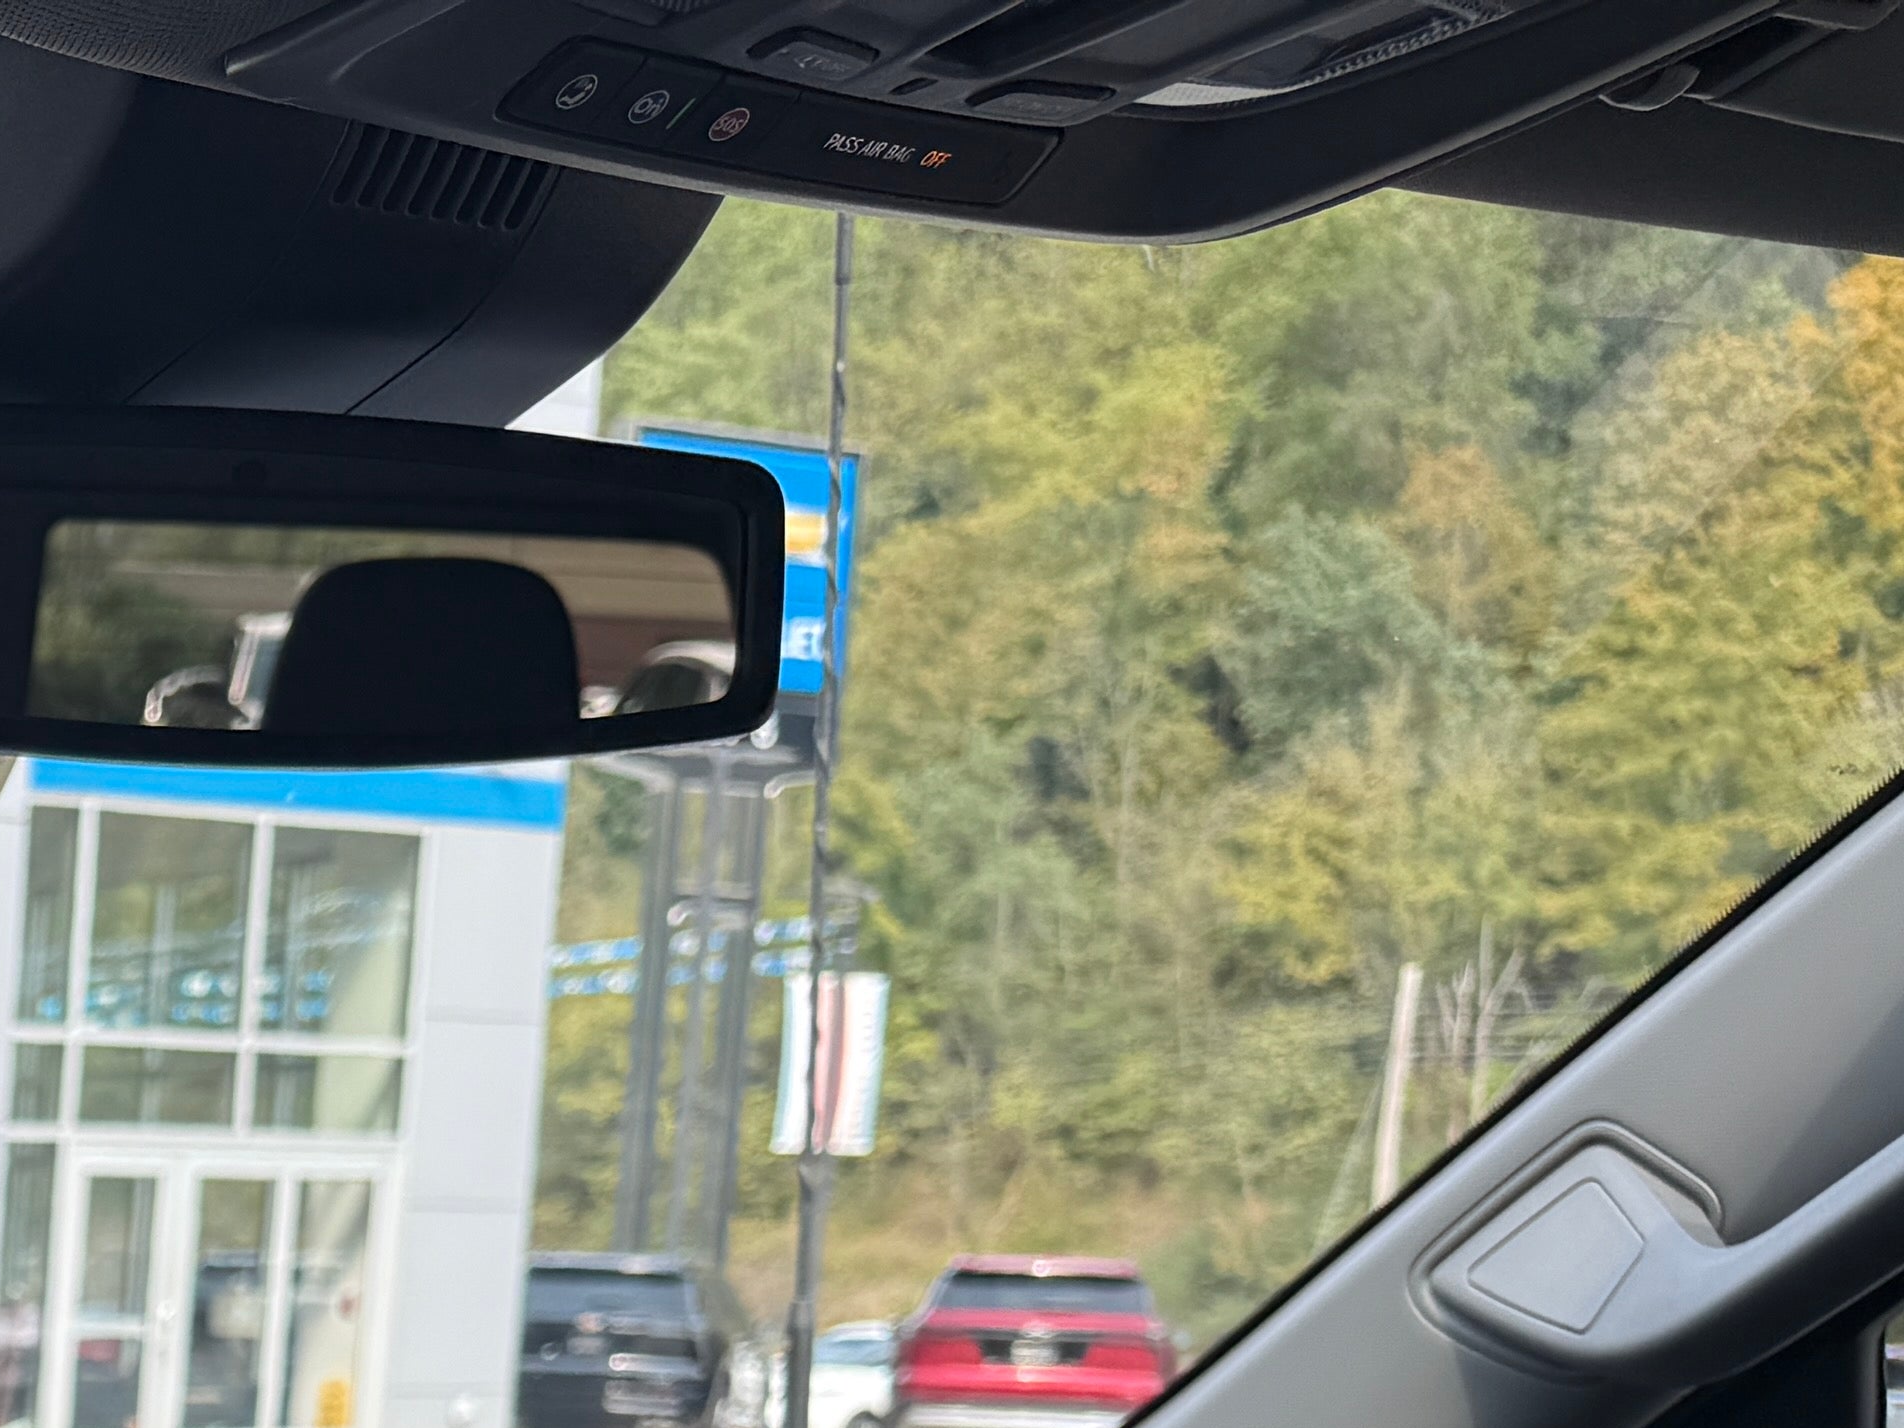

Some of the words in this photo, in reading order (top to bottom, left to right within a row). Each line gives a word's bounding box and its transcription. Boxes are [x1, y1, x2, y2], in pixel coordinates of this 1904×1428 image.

[715, 115, 746, 134] SOS
[822, 132, 861, 155] PASS
[859, 137, 885, 158] AIR
[883, 143, 913, 163] BAG
[919, 149, 952, 169] OFF
